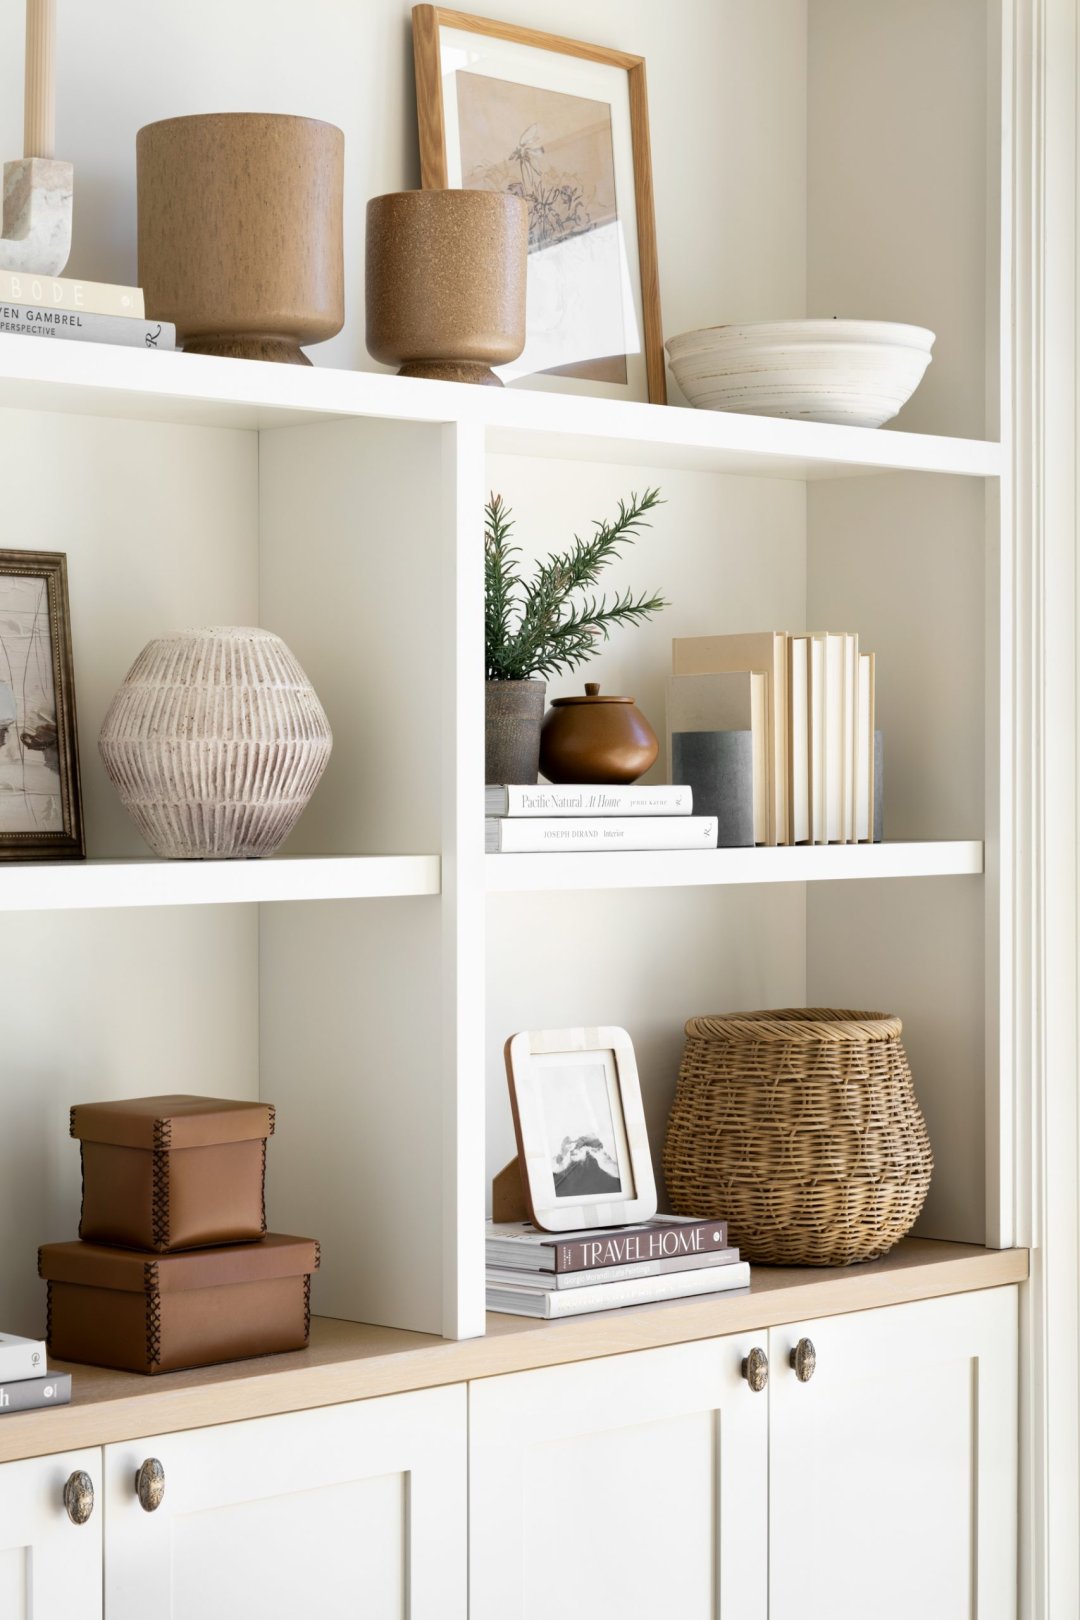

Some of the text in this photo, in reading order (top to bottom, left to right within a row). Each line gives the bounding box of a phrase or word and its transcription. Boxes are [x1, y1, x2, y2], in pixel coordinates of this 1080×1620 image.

[0, 306, 83, 327] EN GAMBREL
[0, 321, 56, 336] PERSPECTIVE
[522, 794, 550, 808] Pacific
[551, 794, 582, 808] Natural
[597, 794, 621, 808] Home
[543, 829, 624, 839] JOSEPH DIRAND Interior
[579, 1236, 645, 1266] TRAVEL
[650, 1227, 705, 1257] HOME
